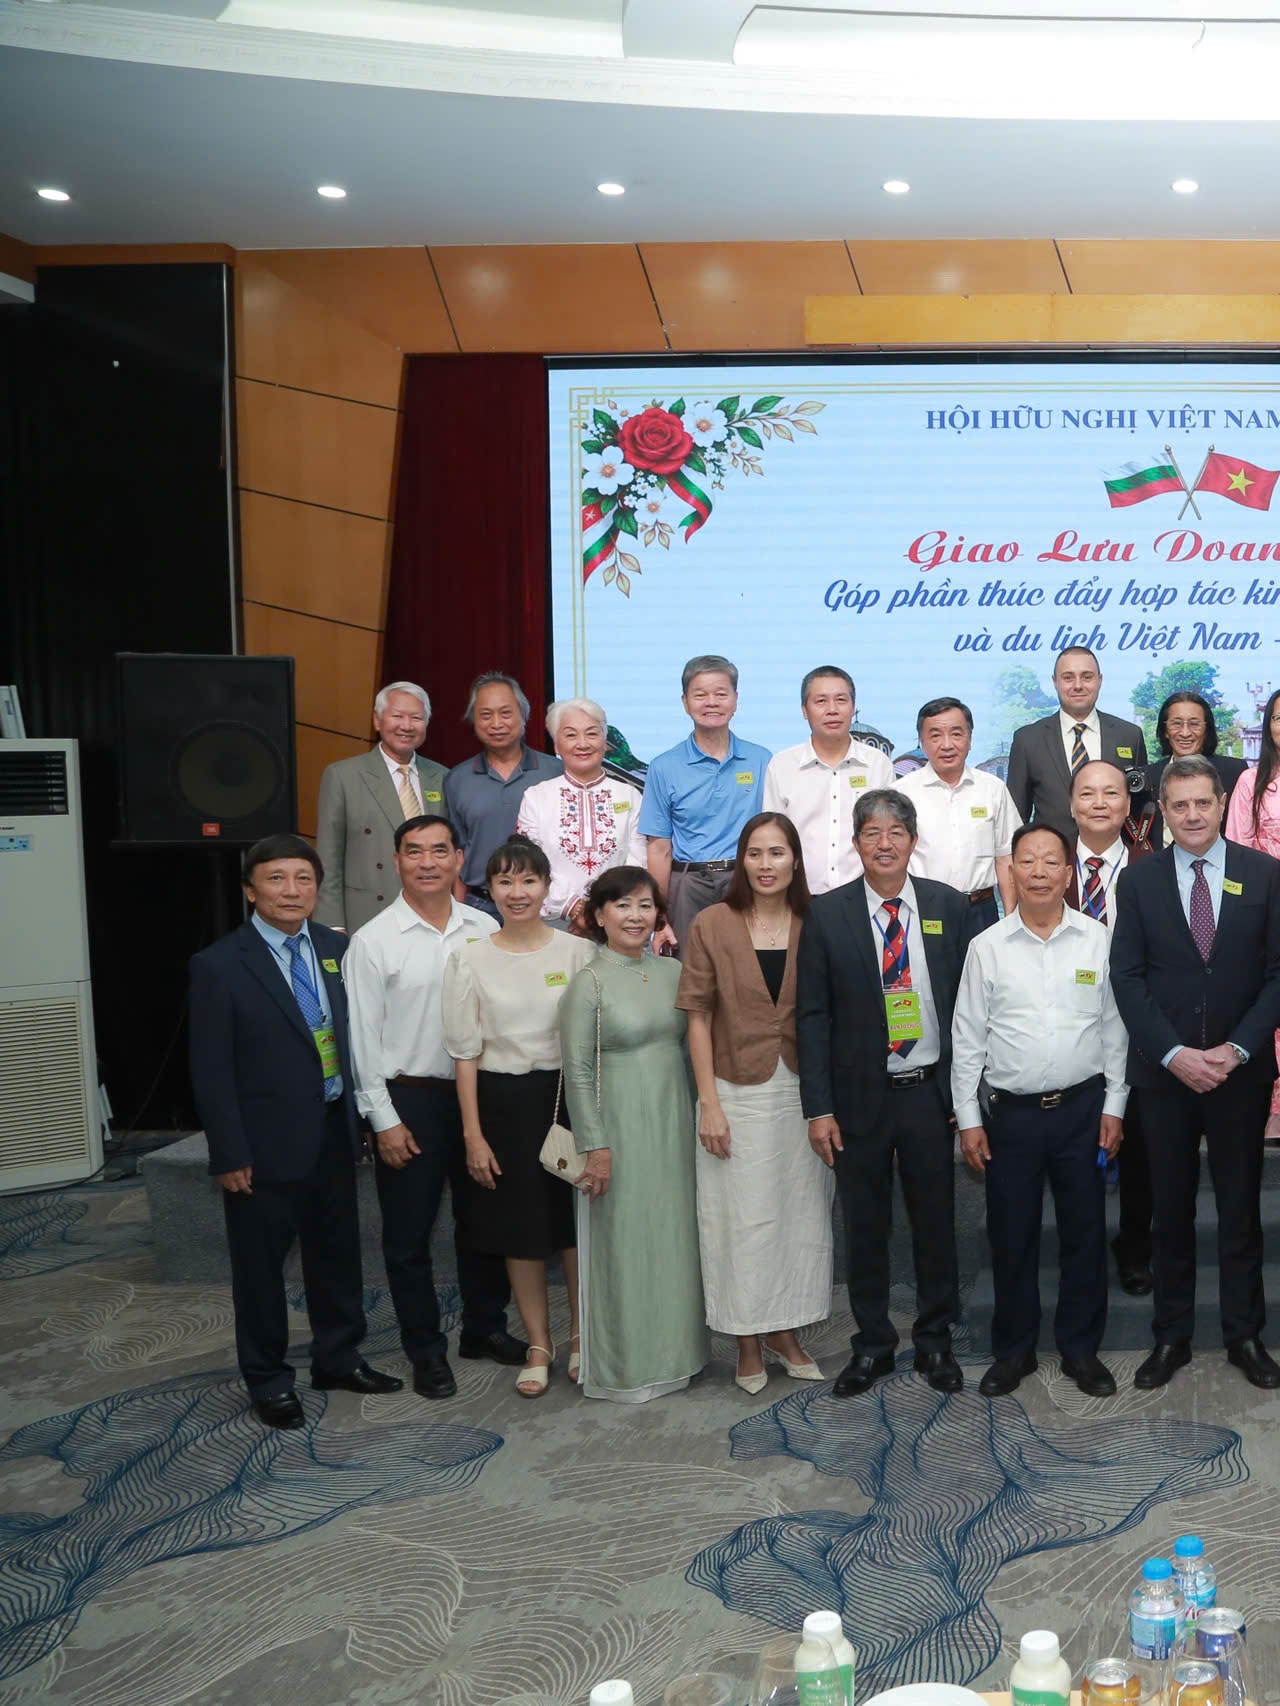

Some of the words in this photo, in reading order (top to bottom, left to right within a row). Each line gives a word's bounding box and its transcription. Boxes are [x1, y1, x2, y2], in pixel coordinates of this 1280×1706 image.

[925, 404, 982, 434] HỘI
[989, 404, 1053, 430] HỮU
[1061, 409, 1138, 434] NGHỊ
[1146, 403, 1216, 434] VIỆT
[903, 530, 1024, 572] Giao
[1037, 529, 1138, 562] Lưu
[824, 579, 881, 614] Góp
[886, 577, 970, 614] phần
[977, 579, 1046, 607] thúc
[1054, 575, 1114, 612] đẩy
[1119, 579, 1179, 614] hợp
[1187, 579, 1237, 606] tác
[953, 626, 993, 652] và
[1002, 624, 1043, 652] du
[1117, 622, 1182, 658] Việt
[1188, 621, 1263, 651] Nam
